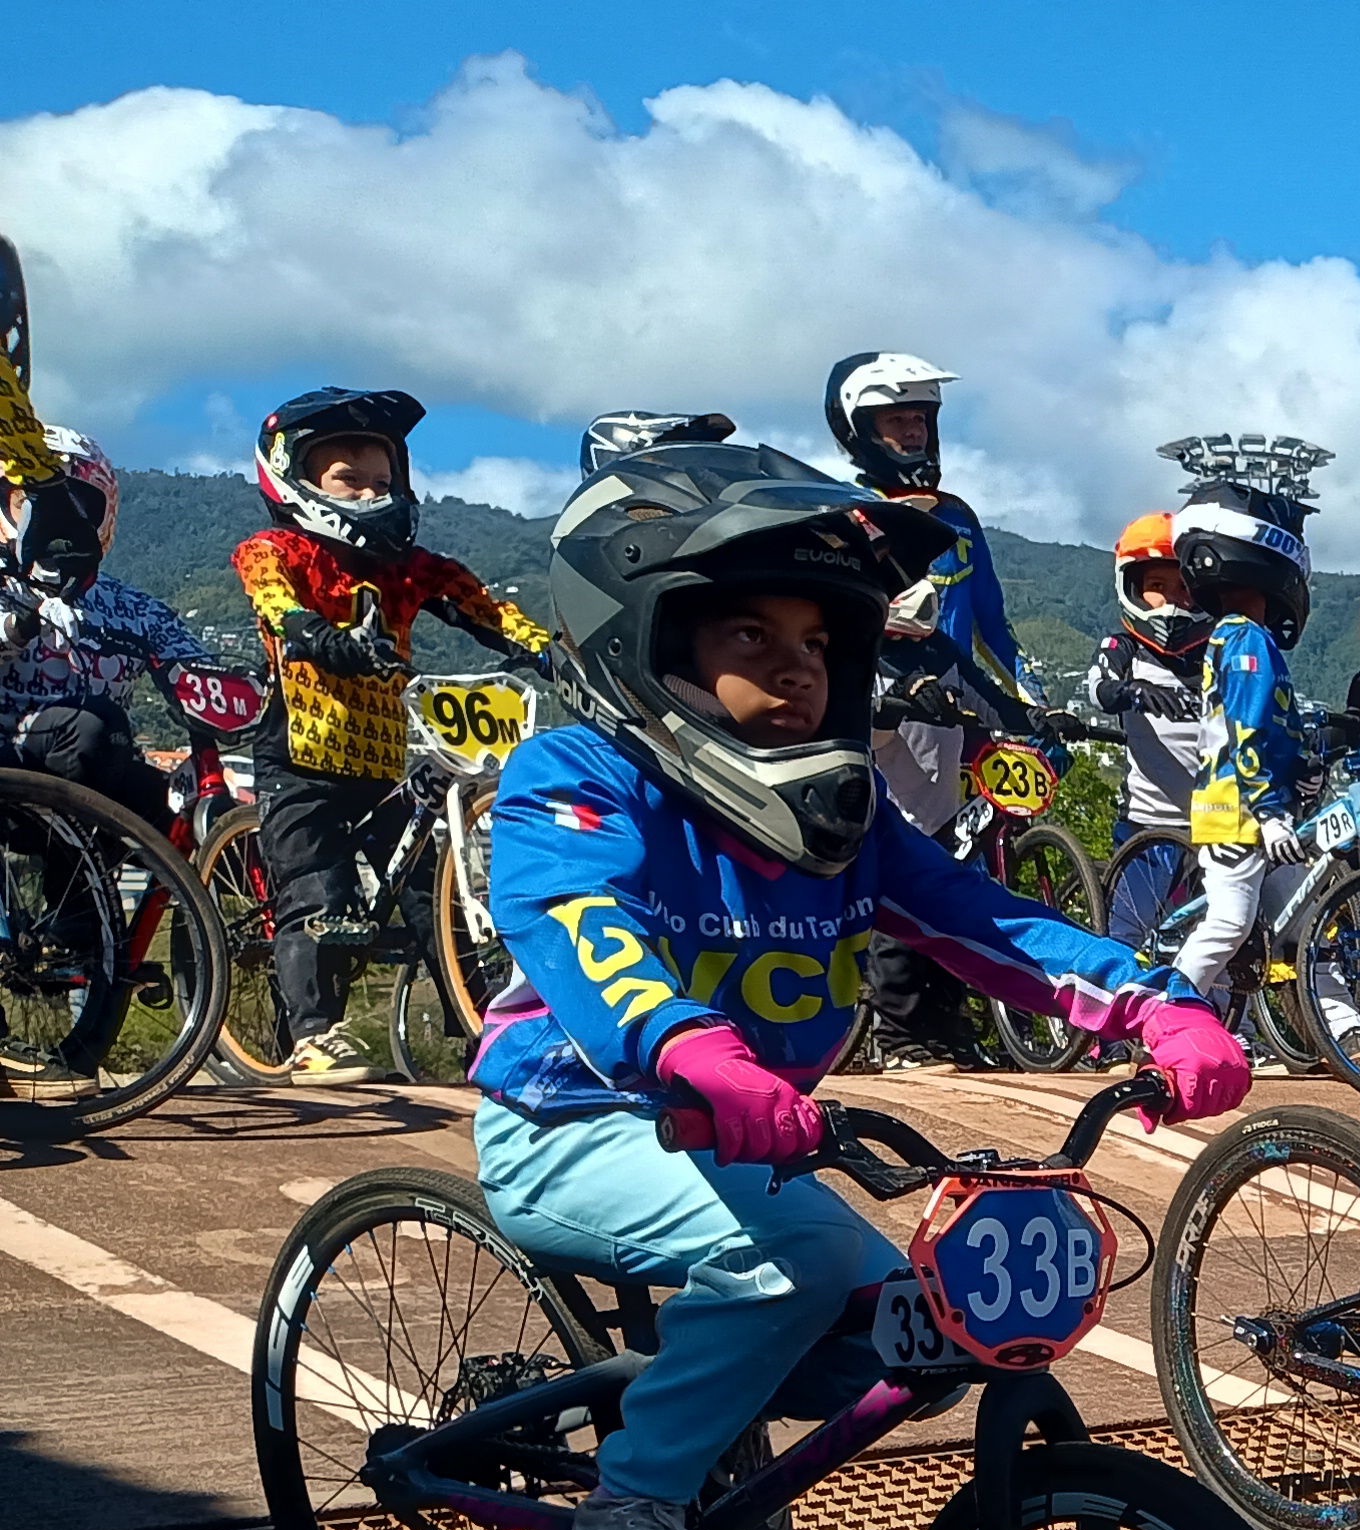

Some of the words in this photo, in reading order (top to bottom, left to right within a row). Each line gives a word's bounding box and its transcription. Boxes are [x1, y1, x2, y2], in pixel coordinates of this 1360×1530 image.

[433, 692, 521, 746] 96M
[1320, 813, 1353, 845] 79R
[967, 1217, 1096, 1321] 33B
